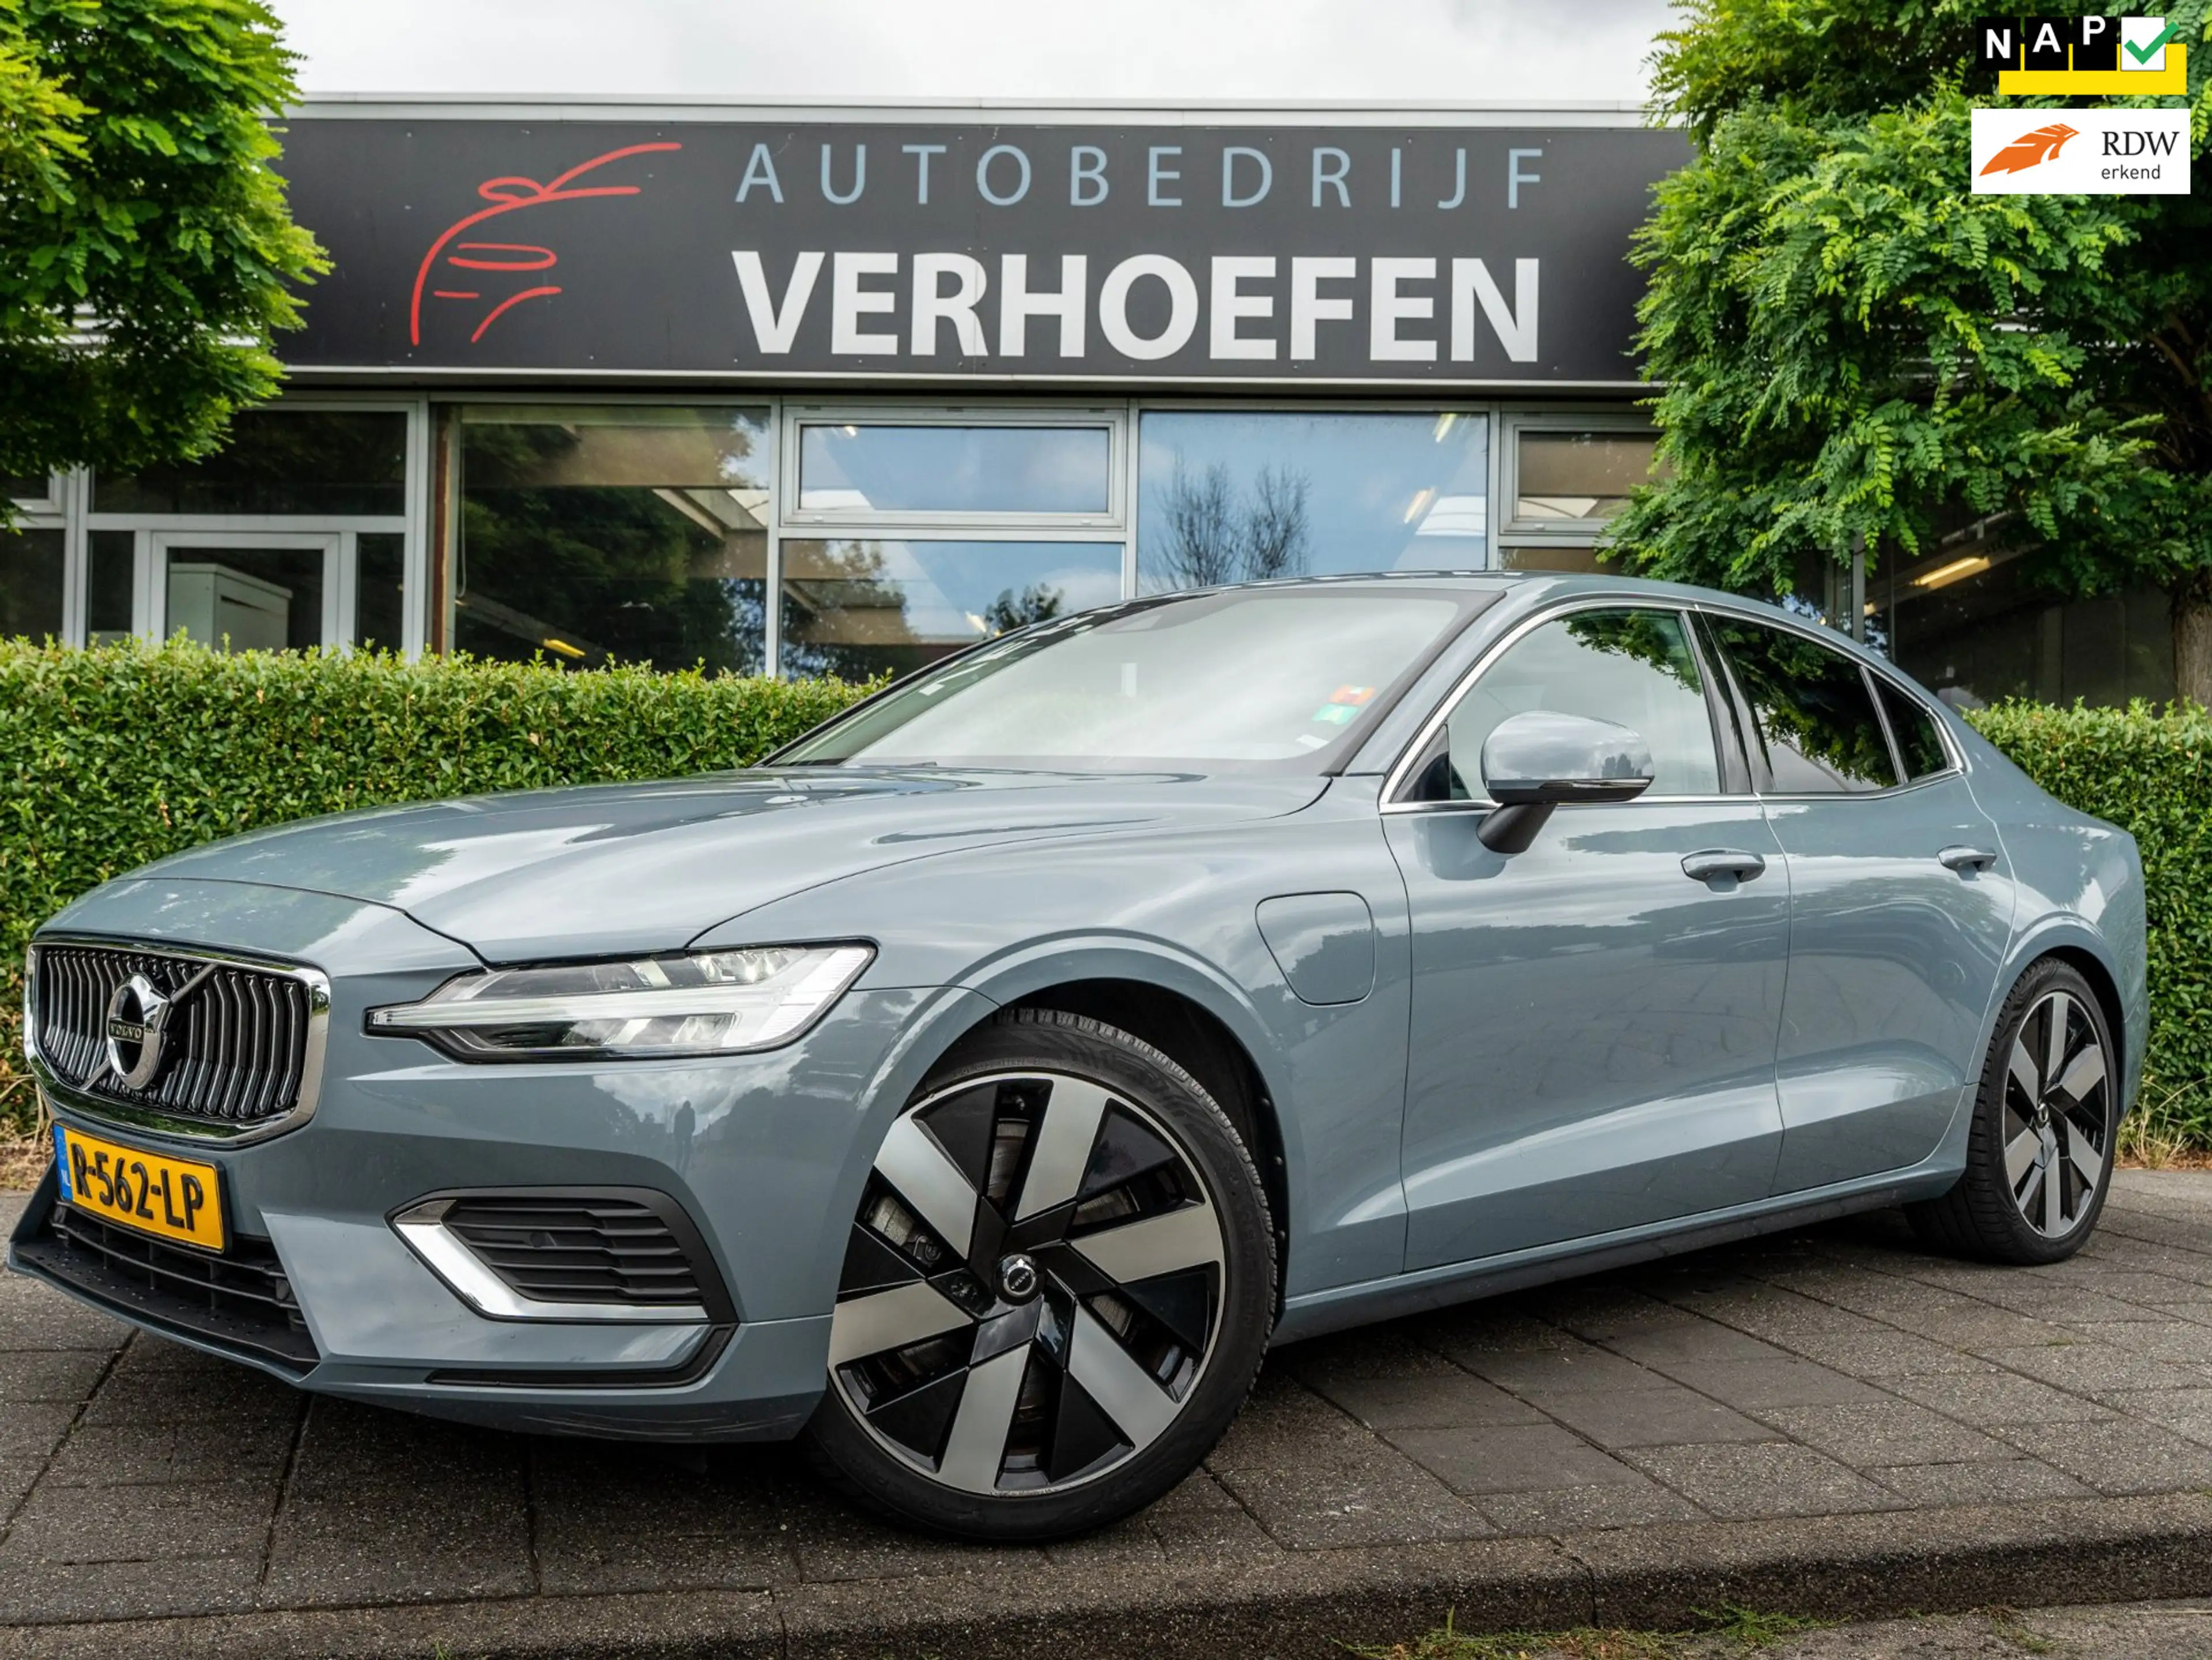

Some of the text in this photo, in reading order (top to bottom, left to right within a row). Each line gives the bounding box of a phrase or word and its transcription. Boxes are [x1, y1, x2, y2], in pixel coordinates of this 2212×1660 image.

[735, 143, 1544, 210] AUTOBEDRIJF
[732, 250, 1539, 362] VERHOEFEN
[110, 1023, 142, 1039] VOLVO
[73, 1143, 203, 1232] R-562-LP
